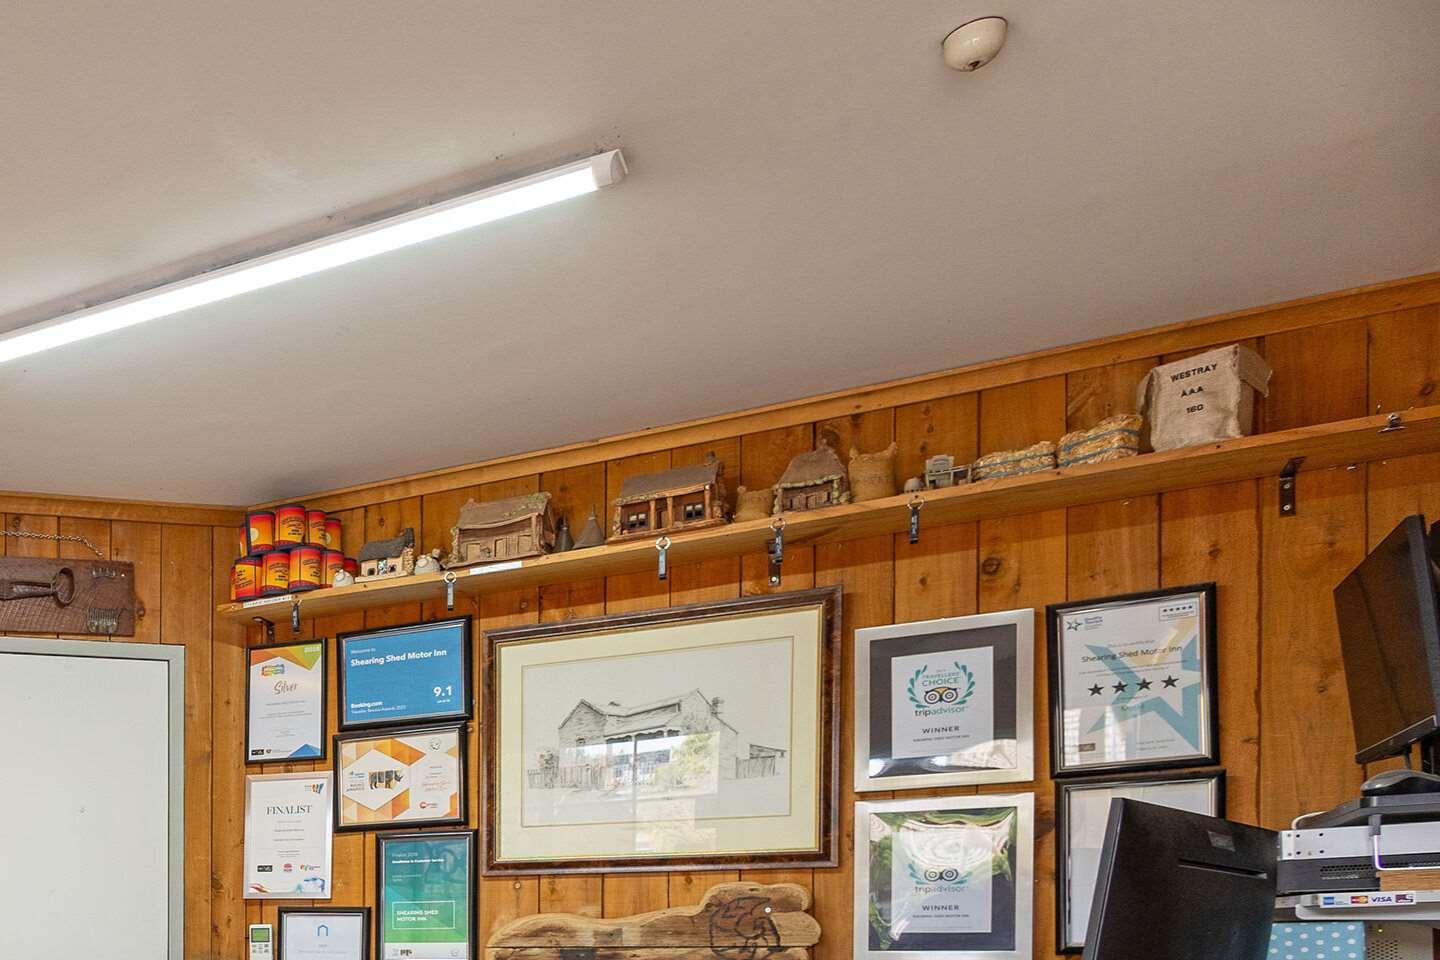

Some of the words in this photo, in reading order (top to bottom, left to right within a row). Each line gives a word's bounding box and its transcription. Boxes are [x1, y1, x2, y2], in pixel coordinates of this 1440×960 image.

[1170, 363, 1217, 383] WESTRAY
[1180, 385, 1205, 398] AAA
[350, 657, 385, 668] Shearing
[385, 653, 406, 664] Shed
[407, 650, 433, 660] Motor
[433, 648, 448, 656] Inn
[1081, 653, 1117, 662] Shearing
[1119, 651, 1139, 659] Shed
[1168, 645, 1182, 653] Inn
[921, 677, 959, 687] CHOICE
[433, 686, 453, 697] 9.1
[915, 705, 965, 717] tripadvisor
[922, 726, 960, 734] WINNER
[265, 804, 313, 816] FINALIST
